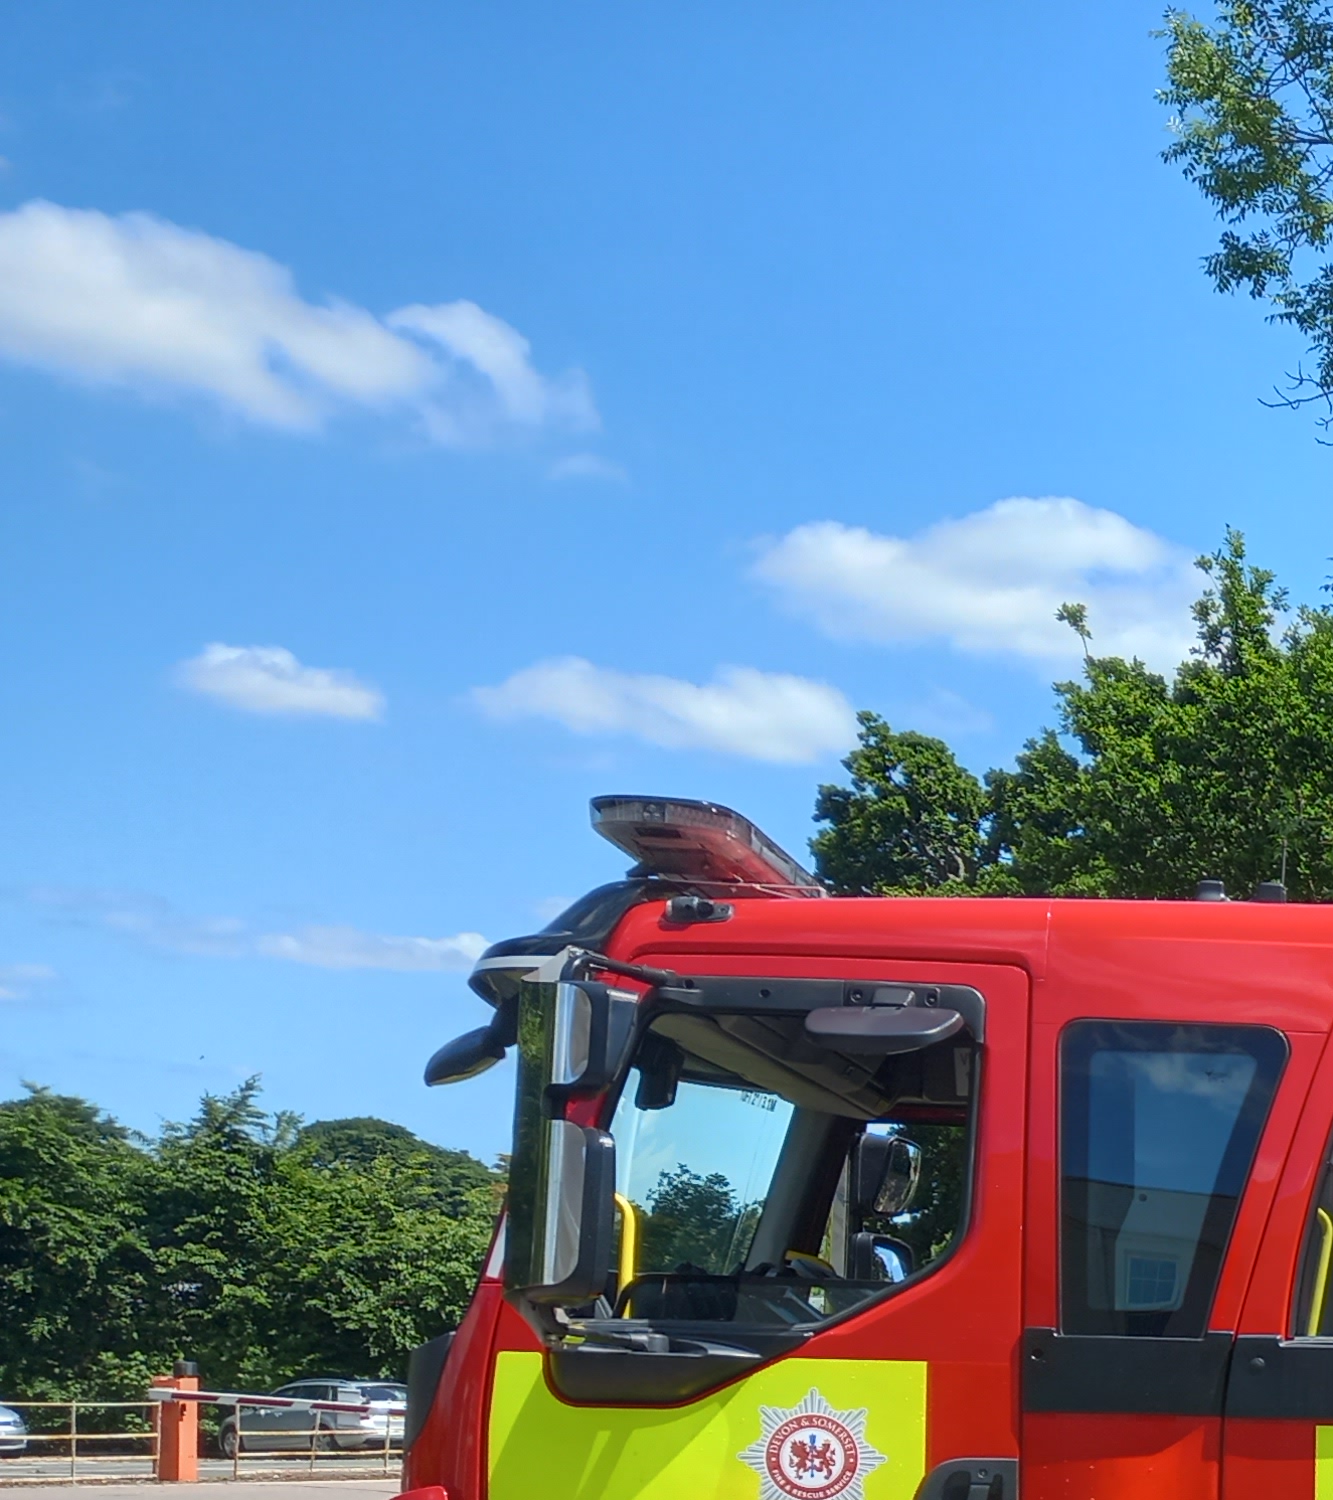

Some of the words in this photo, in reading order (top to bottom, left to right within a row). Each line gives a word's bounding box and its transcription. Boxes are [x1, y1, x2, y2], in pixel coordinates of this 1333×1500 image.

[769, 1420, 799, 1454] DEVON
[800, 1417, 810, 1427] &
[812, 1416, 856, 1456] SOMERSET
[771, 1469, 786, 1486] FIRE
[791, 1488, 825, 1499] RESCUE
[826, 1470, 853, 1496] SERVICE
